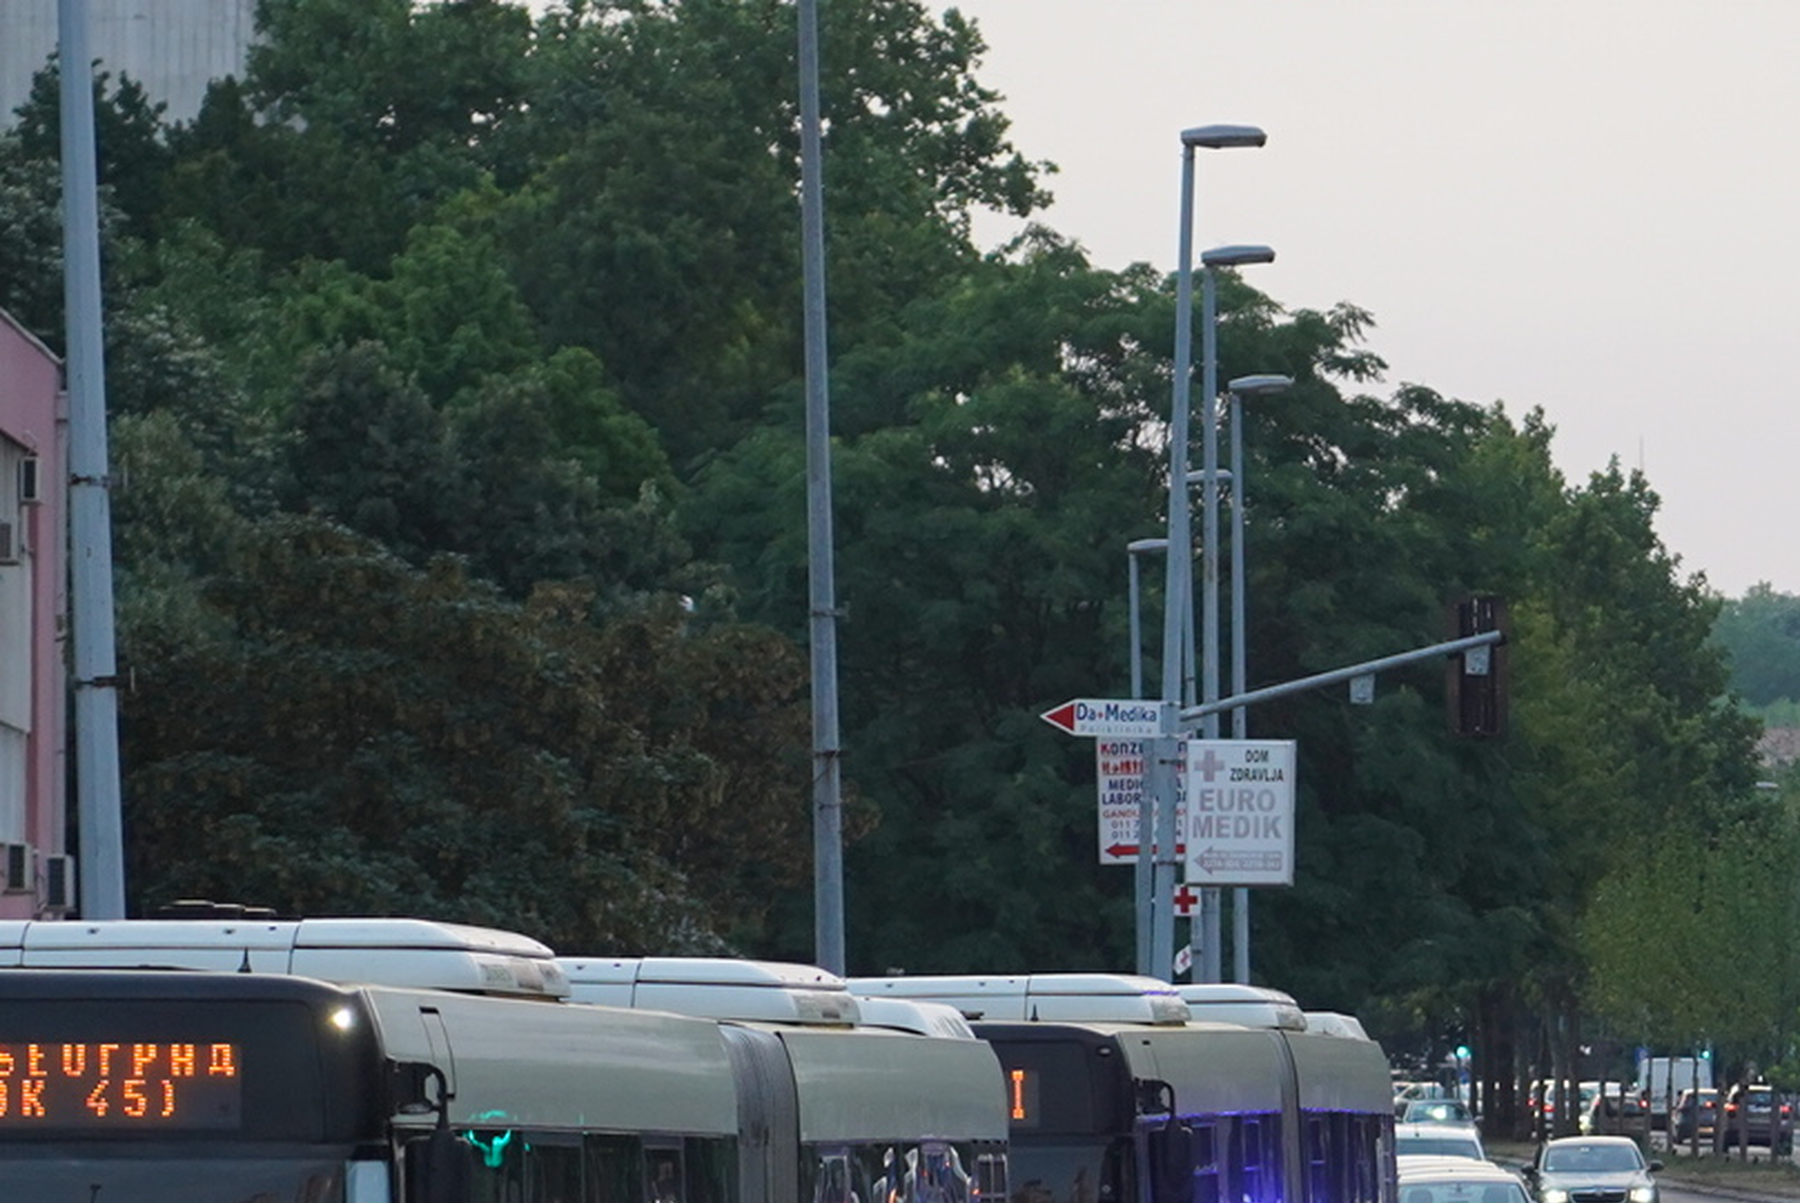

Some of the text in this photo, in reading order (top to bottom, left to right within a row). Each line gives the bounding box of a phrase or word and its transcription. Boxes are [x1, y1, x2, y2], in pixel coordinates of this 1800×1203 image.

[1245, 749, 1269, 763] DOM
[1230, 767, 1284, 782] ZDRAVLJA
[1200, 788, 1276, 813] EURO
[1192, 815, 1282, 839] MEDIK
